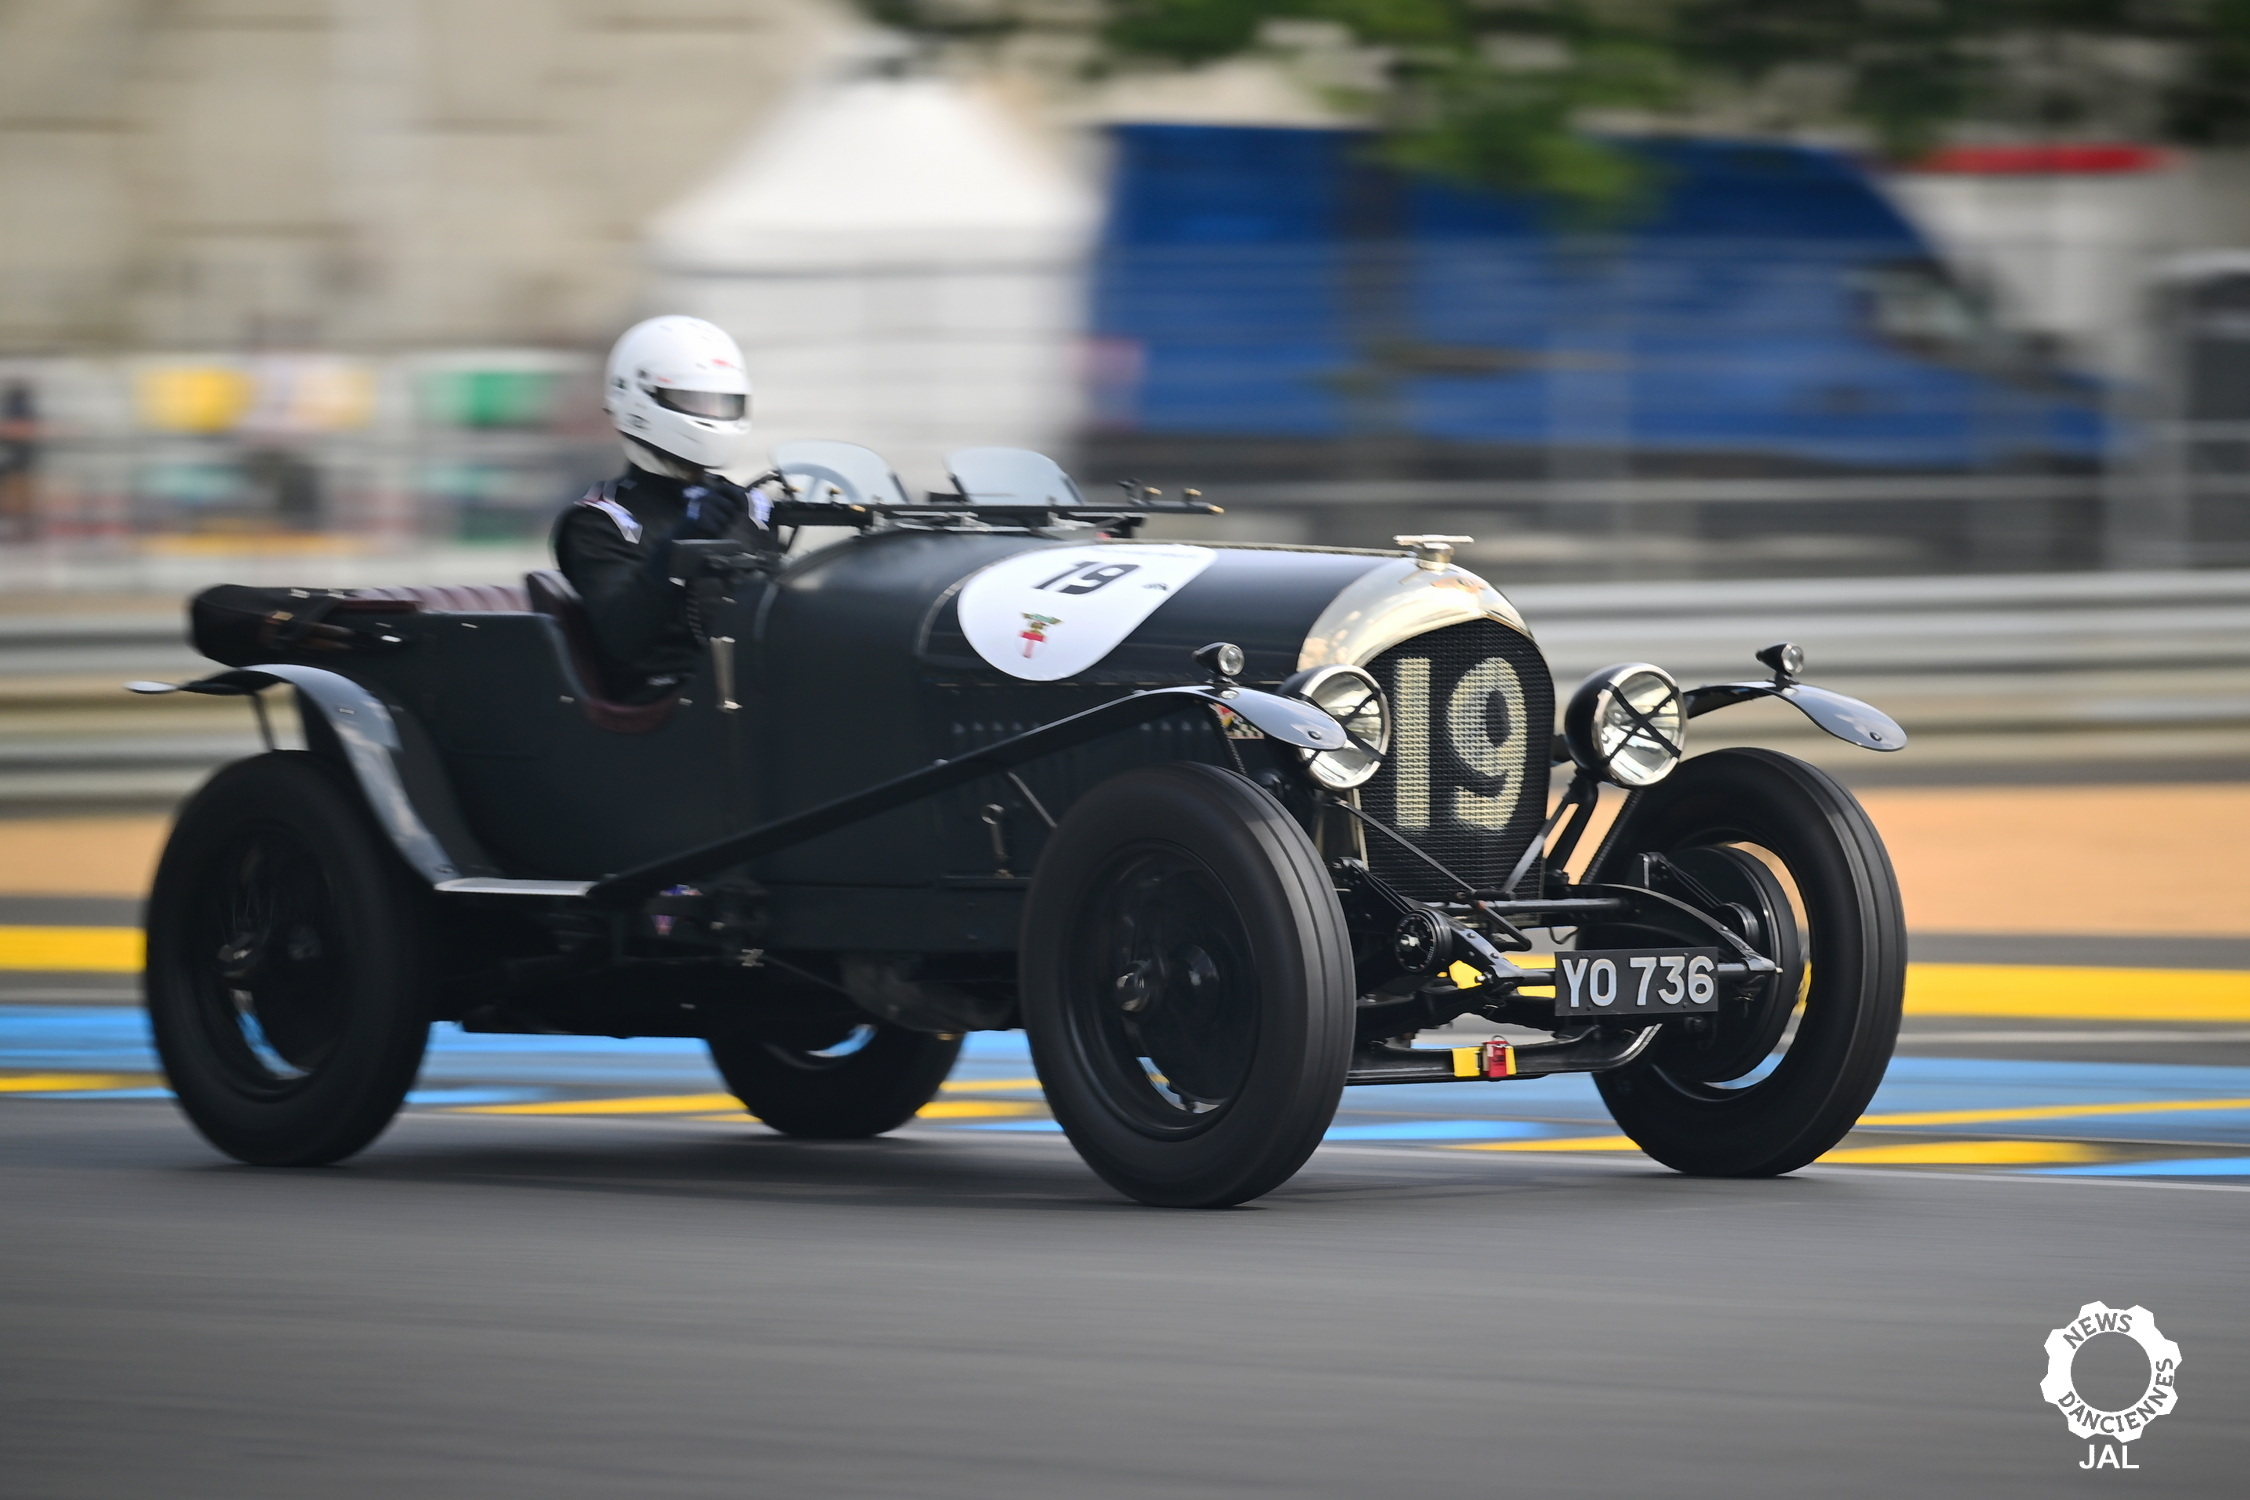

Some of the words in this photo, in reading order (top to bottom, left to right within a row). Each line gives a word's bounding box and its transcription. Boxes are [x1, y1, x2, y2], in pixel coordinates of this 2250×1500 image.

[1033, 561, 1141, 595] 19
[1394, 657, 1527, 830] 19
[1561, 958, 1617, 1007] YO
[1630, 955, 1715, 1006] 736
